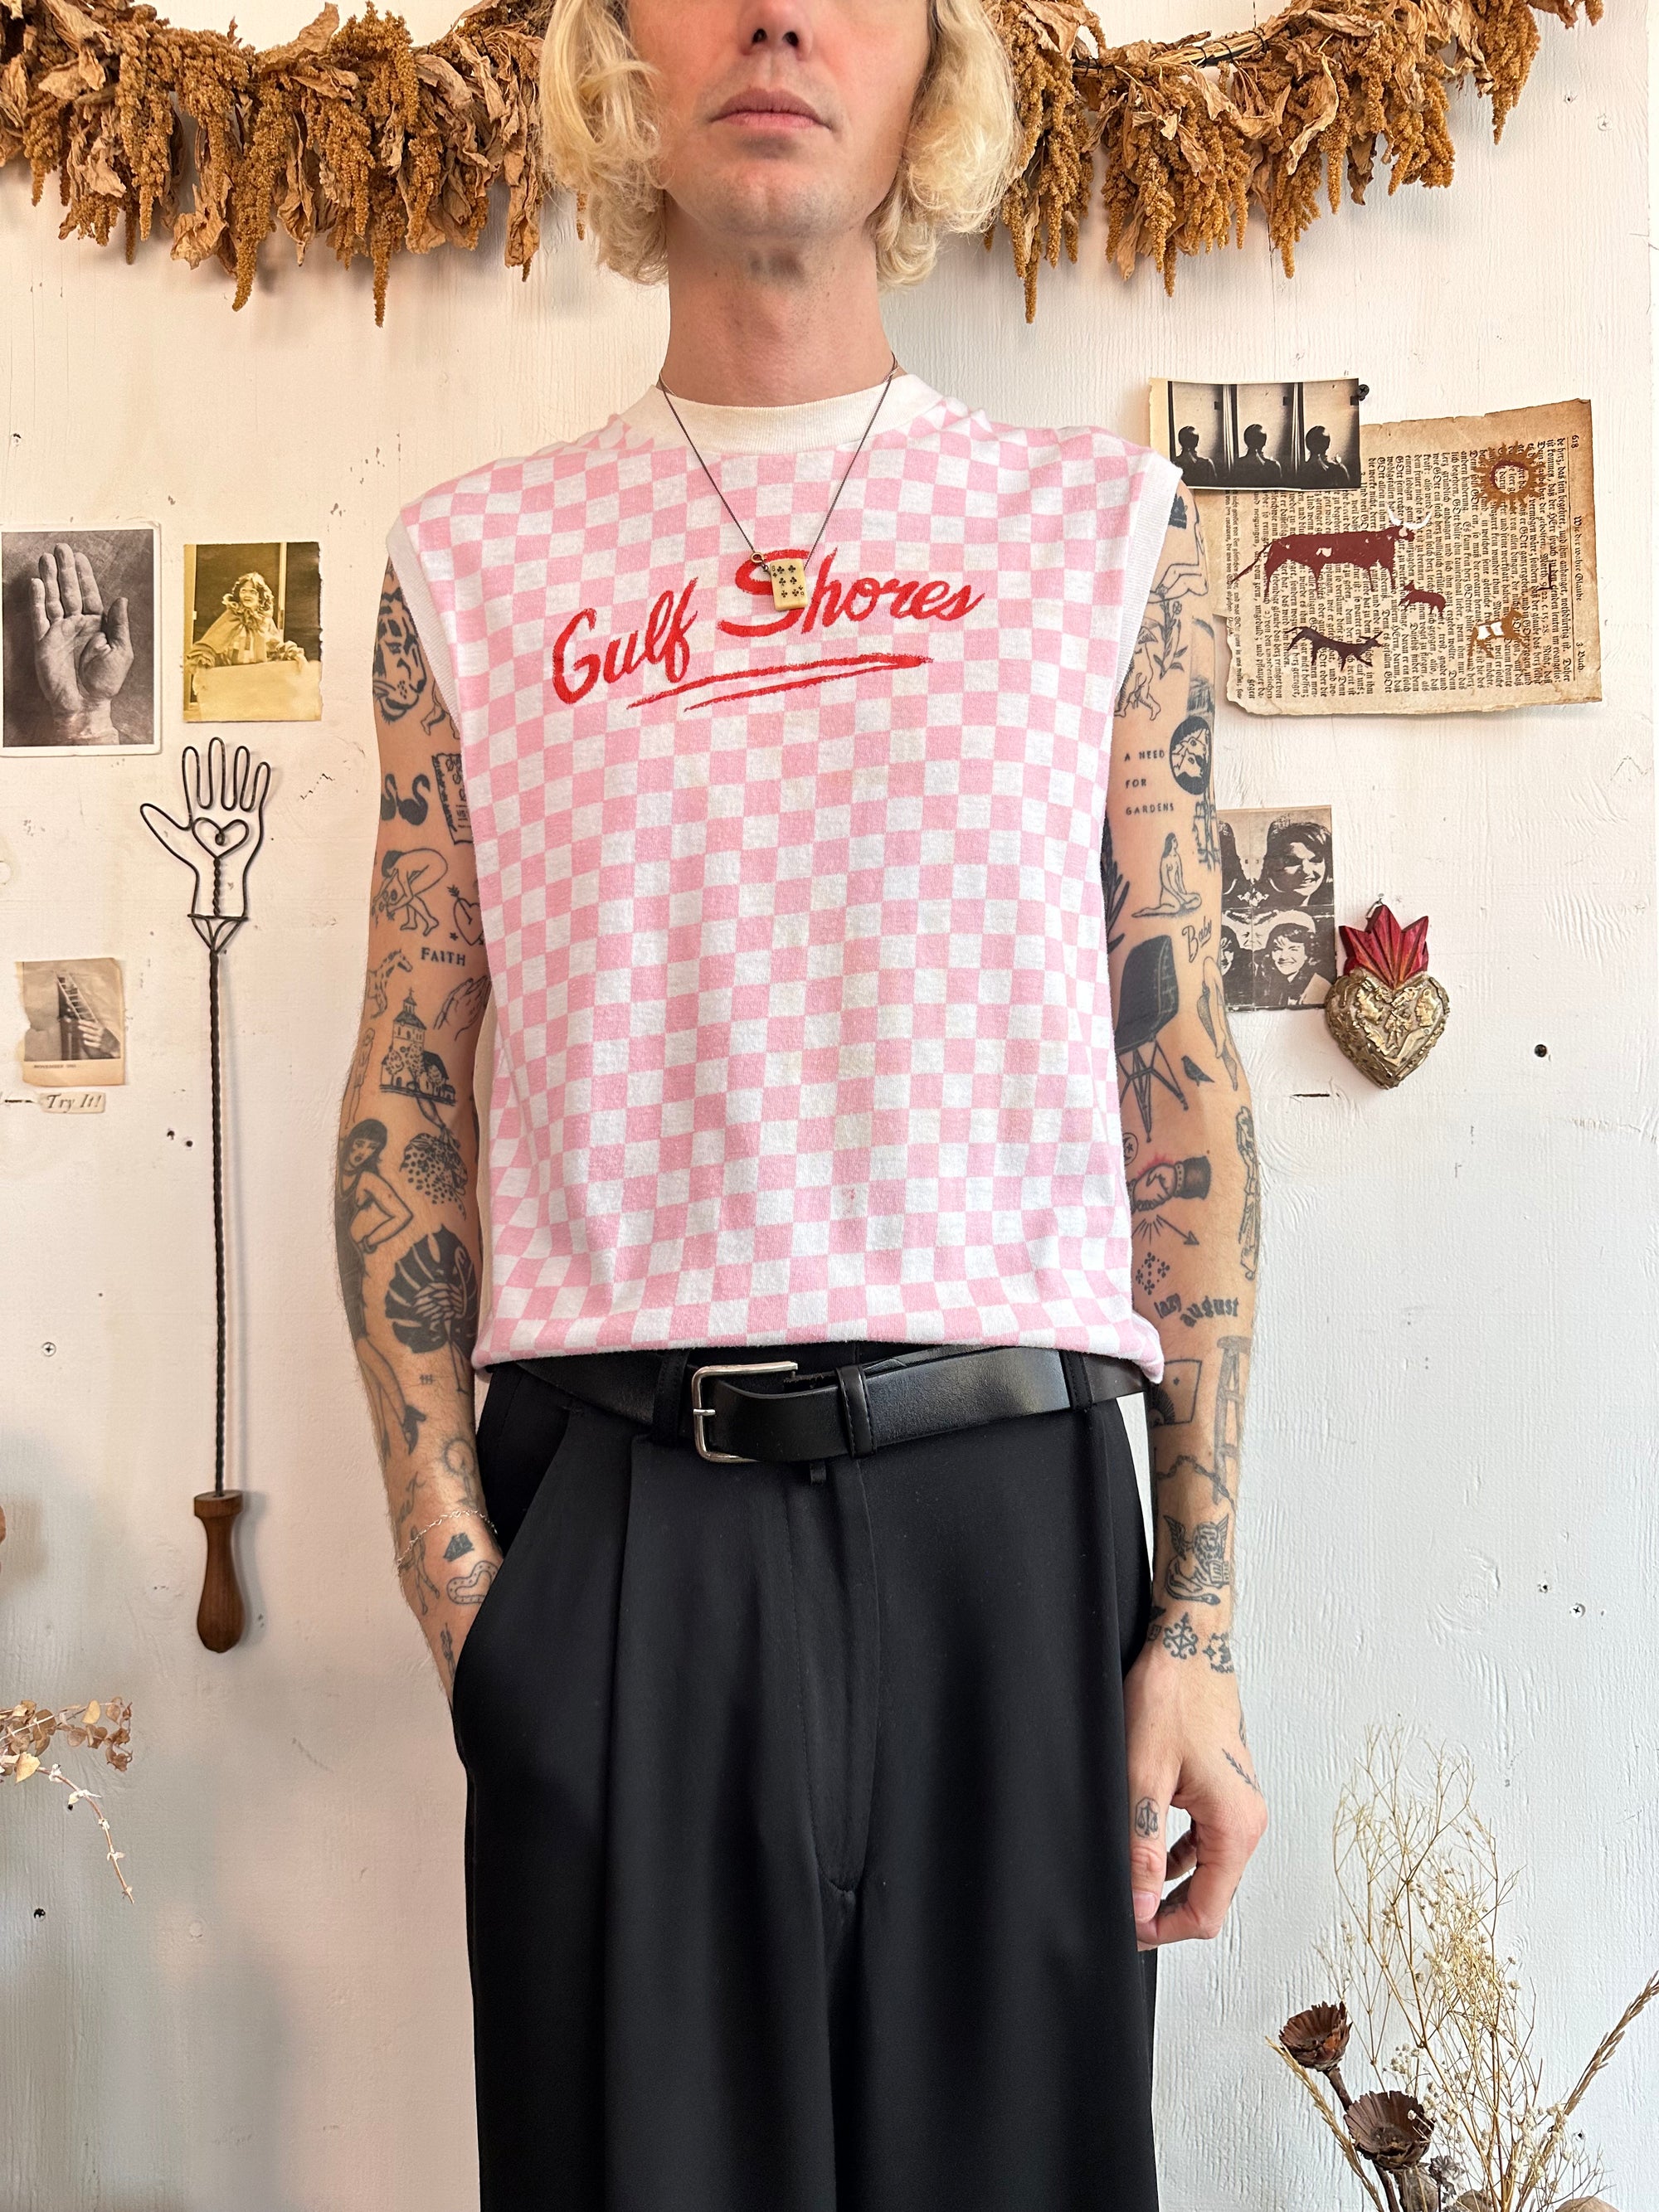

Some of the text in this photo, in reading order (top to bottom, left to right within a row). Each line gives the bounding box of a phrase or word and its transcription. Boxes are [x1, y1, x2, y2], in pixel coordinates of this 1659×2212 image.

[552, 547, 986, 705] Gulf Shores
[1124, 749, 1165, 761] A NEED
[1125, 778, 1147, 789] FOR
[1126, 802, 1175, 816] GARDENS
[1181, 916, 1213, 964] Baby
[421, 946, 467, 967] FAITH
[46, 1093, 102, 1114] Try It!
[1179, 1295, 1239, 1329] august
